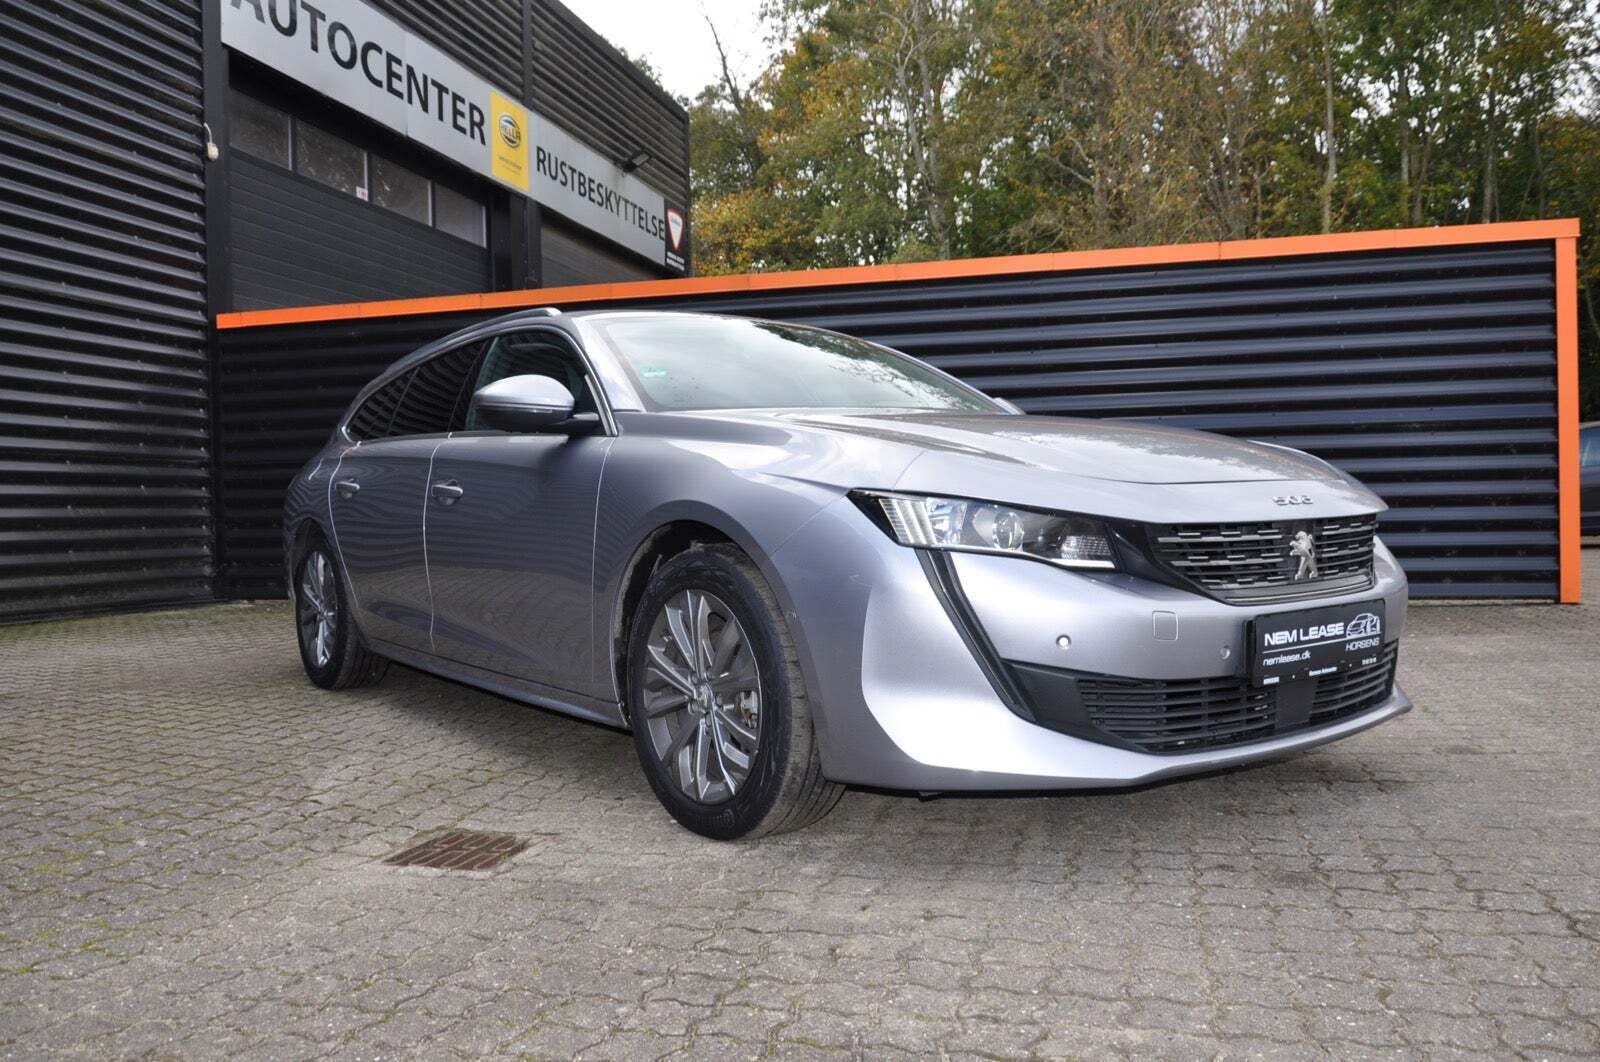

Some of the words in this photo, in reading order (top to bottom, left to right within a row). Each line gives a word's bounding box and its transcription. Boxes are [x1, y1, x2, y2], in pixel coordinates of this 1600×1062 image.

[536, 145, 665, 241] RUSTBESKYTTELSE
[1264, 629, 1297, 646] NEM
[1299, 622, 1344, 641] LEASE
[1345, 637, 1380, 652] HORSENS
[1262, 649, 1312, 666] nemlease.dk
